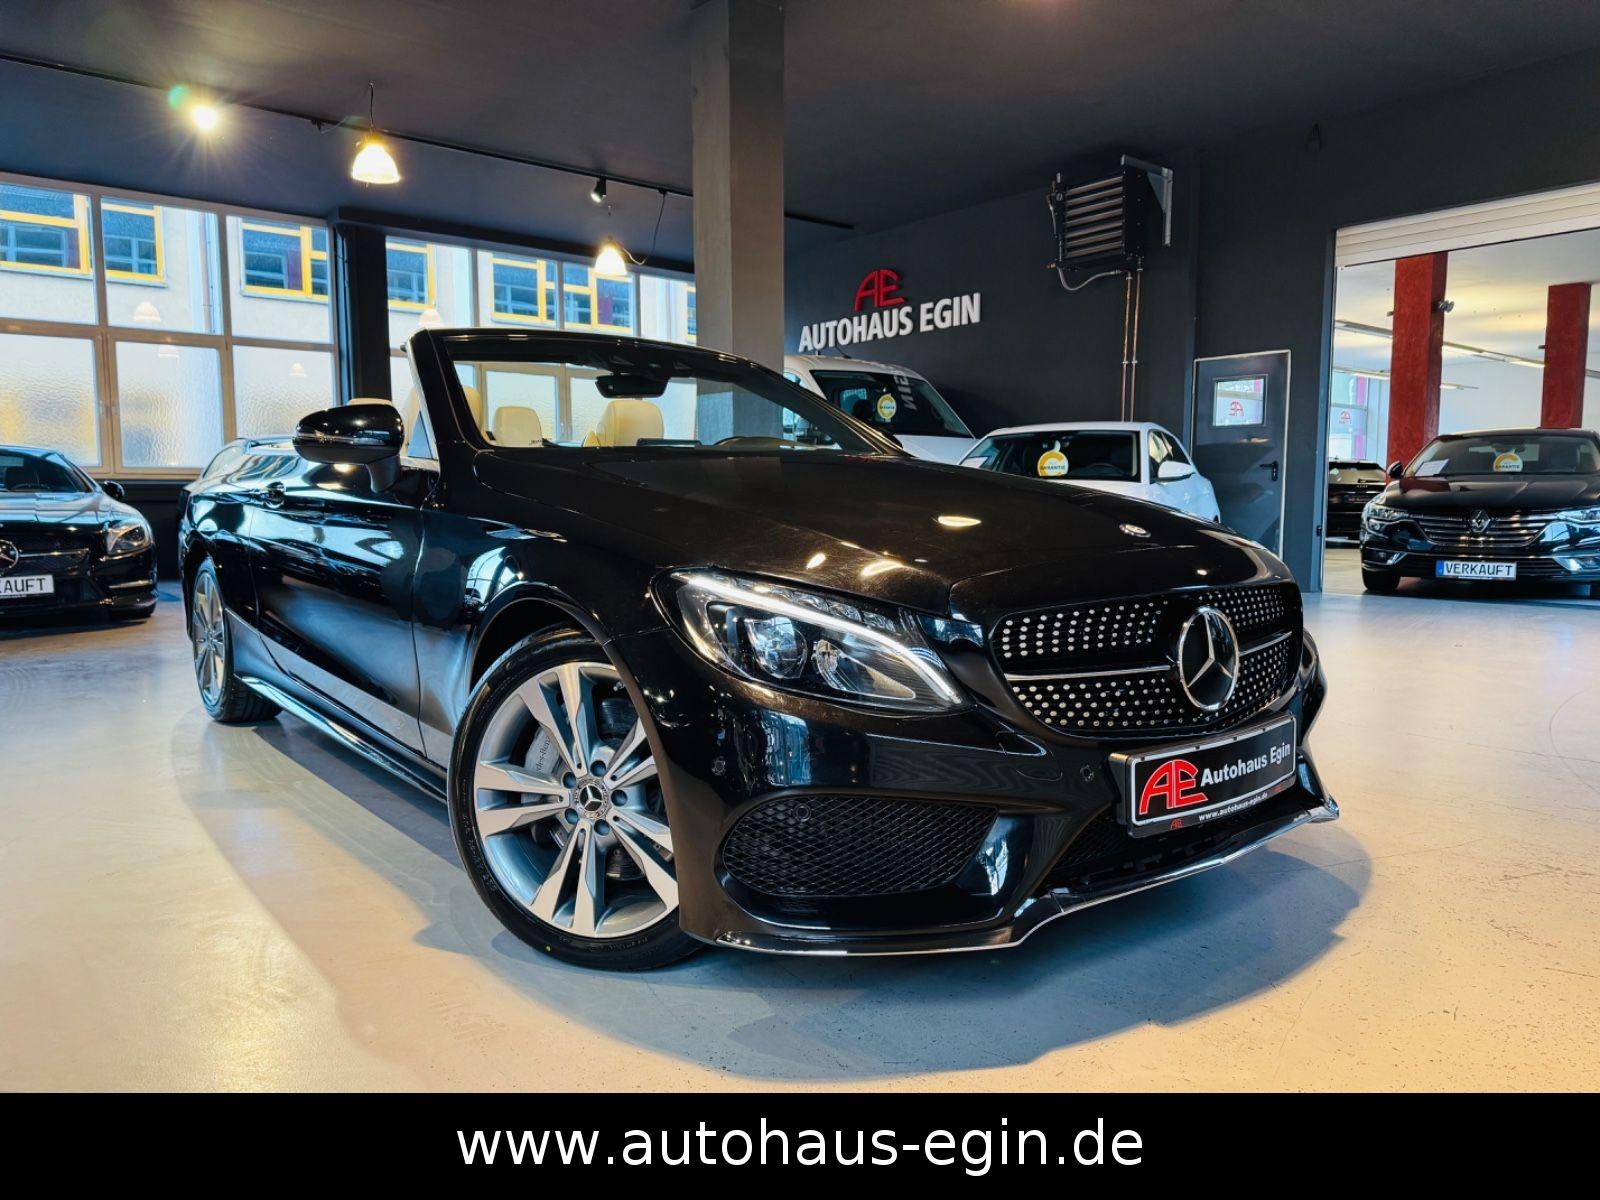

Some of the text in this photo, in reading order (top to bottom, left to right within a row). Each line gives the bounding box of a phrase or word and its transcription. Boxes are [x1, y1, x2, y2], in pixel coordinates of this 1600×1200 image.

[798, 292, 981, 352] AUTOHAUS EGIN
[1445, 563, 1513, 576] VERKAUFT
[0, 577, 46, 593] AUFT
[1200, 759, 1268, 787] Autohaus
[1270, 742, 1291, 766] Egin
